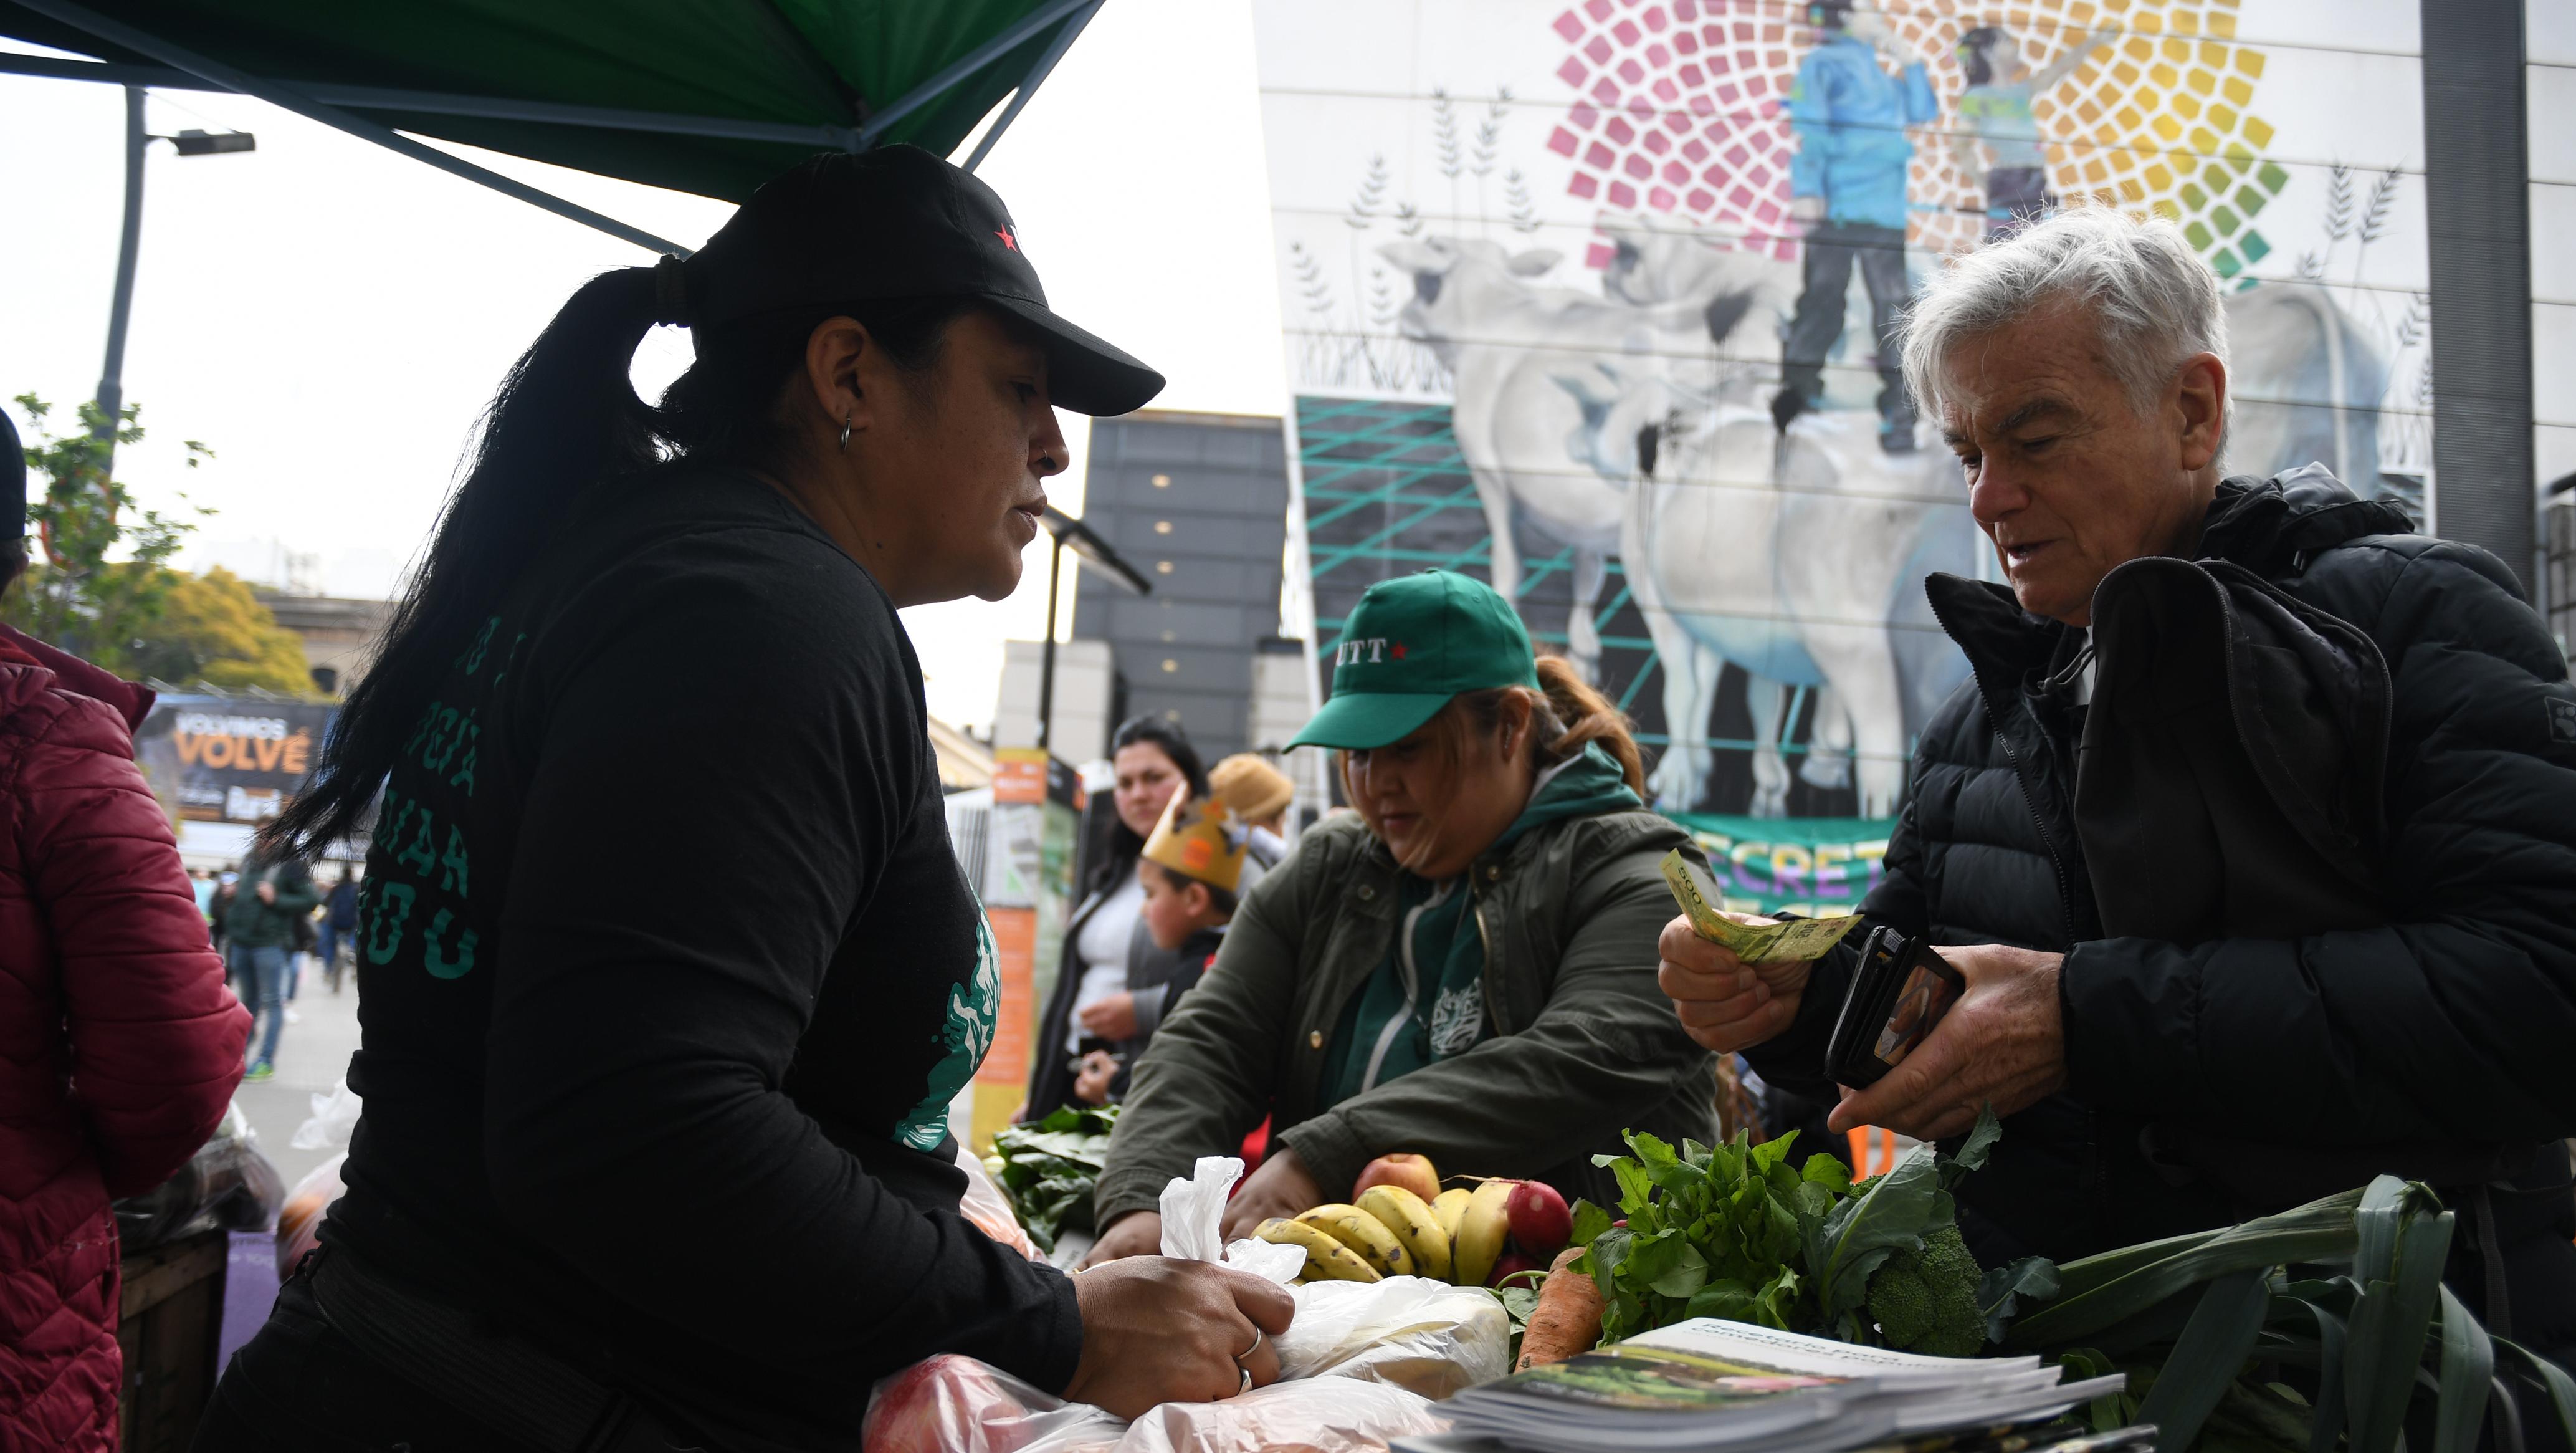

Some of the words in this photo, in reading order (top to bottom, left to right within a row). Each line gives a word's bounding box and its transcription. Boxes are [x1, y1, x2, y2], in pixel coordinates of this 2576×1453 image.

[1336, 638, 1386, 667] UTT
[176, 712, 287, 741] VOLVIMOS
[174, 727, 310, 775] VOLVÉ
[1678, 866, 1702, 904] 500
[1691, 1327, 1834, 1356] comedores
[1702, 1323, 1826, 1350] Recetario
[1832, 1348, 1899, 1362] para
